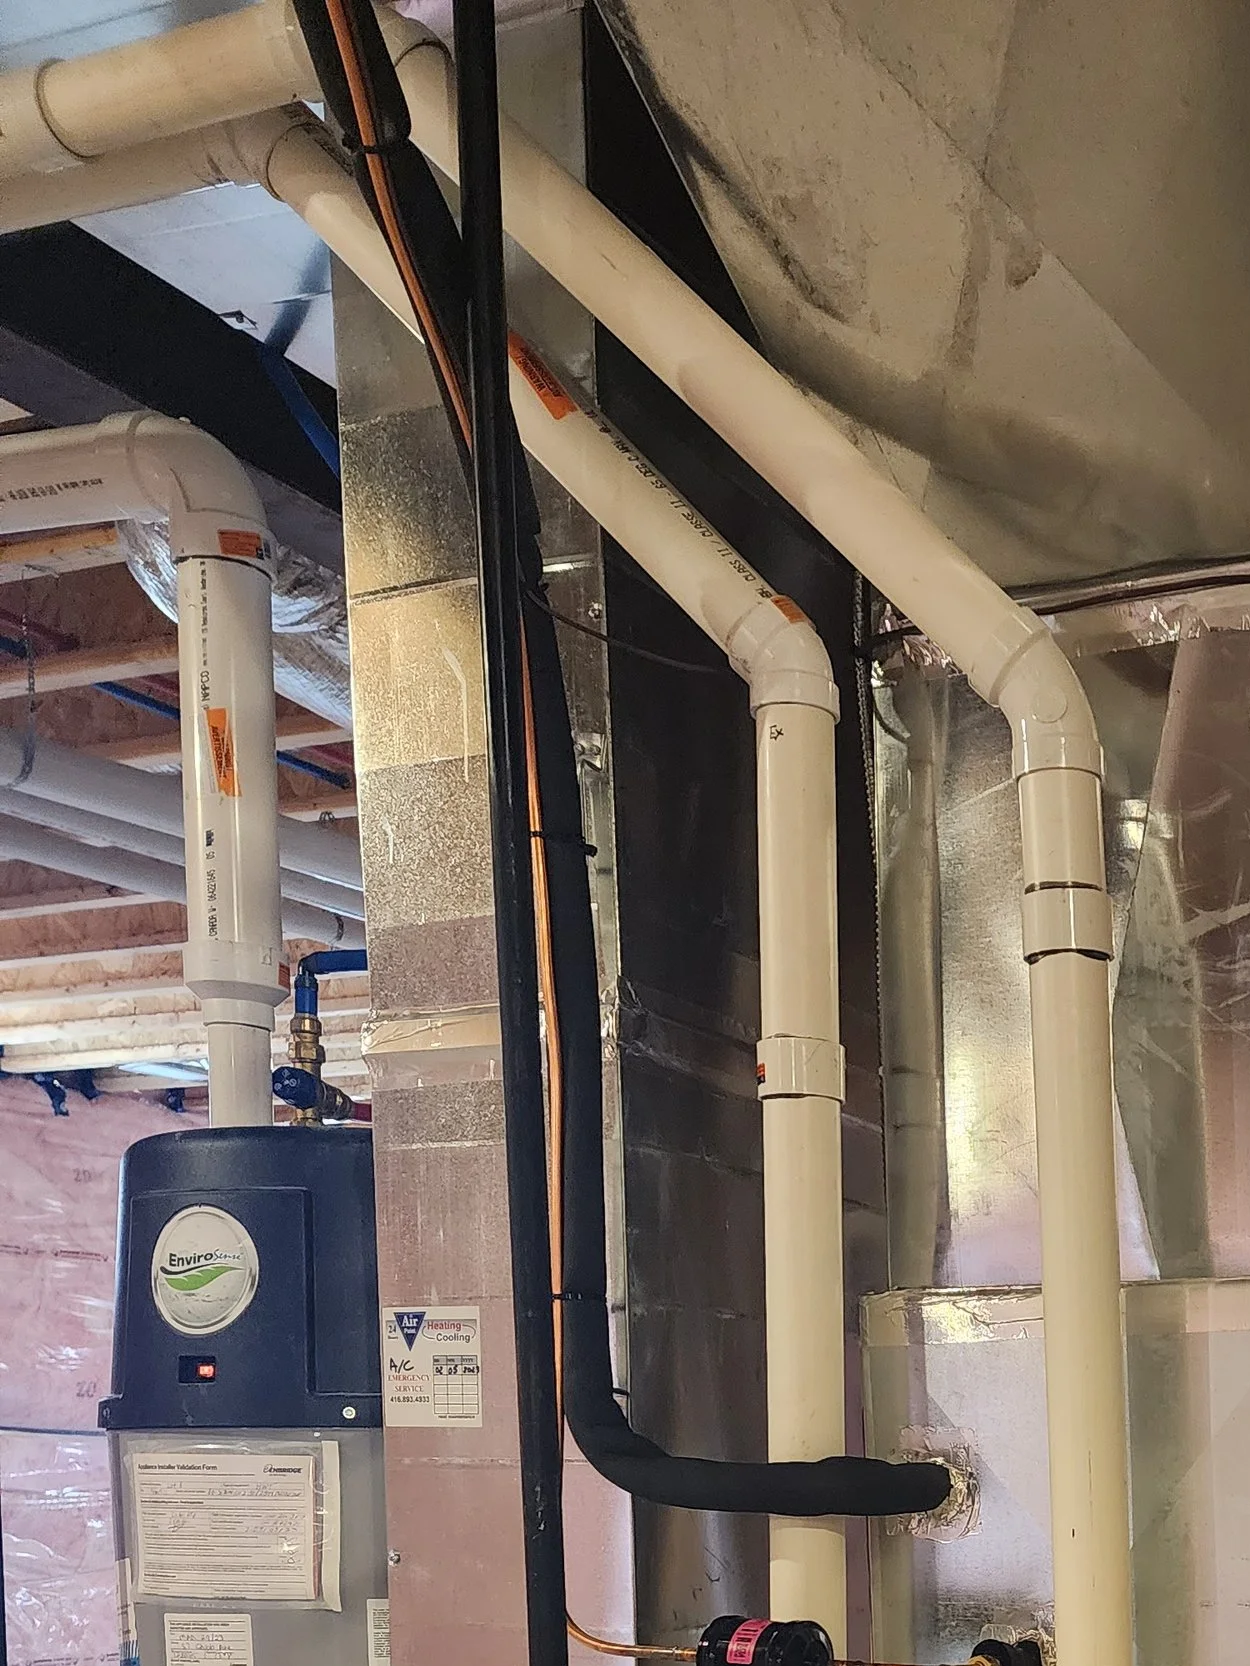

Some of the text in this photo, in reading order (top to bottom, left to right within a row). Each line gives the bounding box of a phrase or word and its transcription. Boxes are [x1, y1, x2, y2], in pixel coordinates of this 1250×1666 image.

[681, 512, 713, 538] CLASSE
[729, 559, 757, 582] CLASS
[201, 670, 210, 704] NAPCO
[401, 1314, 419, 1327] Air
[427, 1321, 462, 1331] Heating
[388, 1325, 397, 1334] 24
[436, 1333, 471, 1344] Cooling
[389, 1357, 415, 1374] A/C
[387, 1374, 430, 1382] EMERGENCY
[394, 1385, 424, 1393] SERVICE
[176, 1463, 201, 1471] Validation
